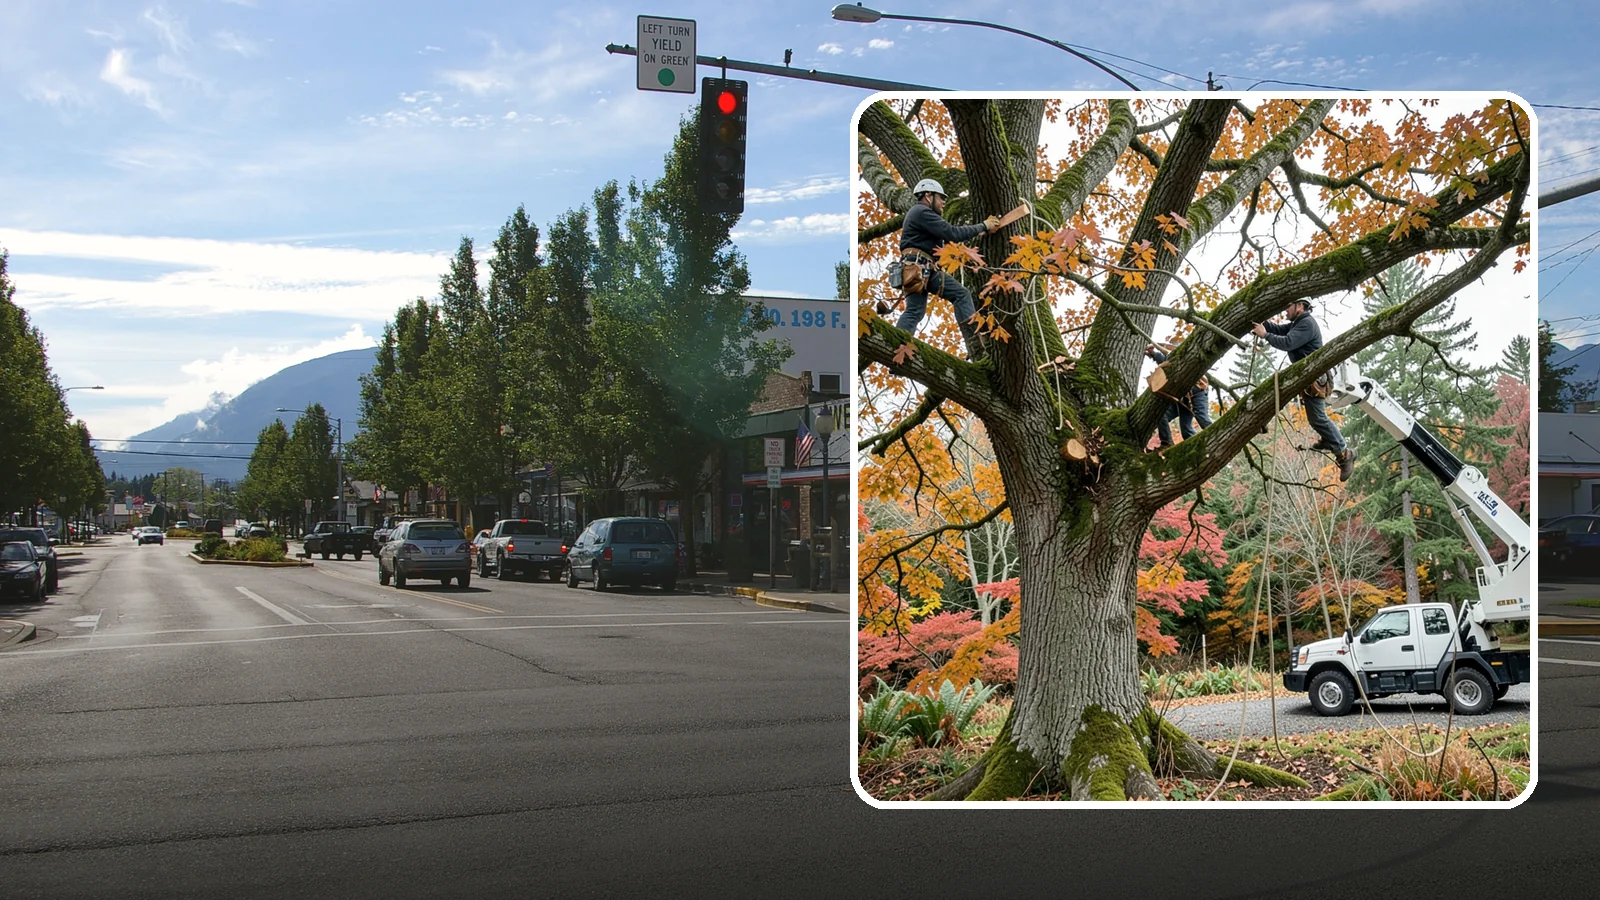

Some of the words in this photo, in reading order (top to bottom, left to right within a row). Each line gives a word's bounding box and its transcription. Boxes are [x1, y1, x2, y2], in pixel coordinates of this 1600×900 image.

[643, 23, 663, 35] LEFT
[668, 25, 690, 37] TURN
[652, 38, 682, 52] YIELD
[644, 54, 656, 64] ON
[661, 55, 689, 66] GREEN
[791, 309, 826, 328] 198
[831, 311, 847, 329] F.
